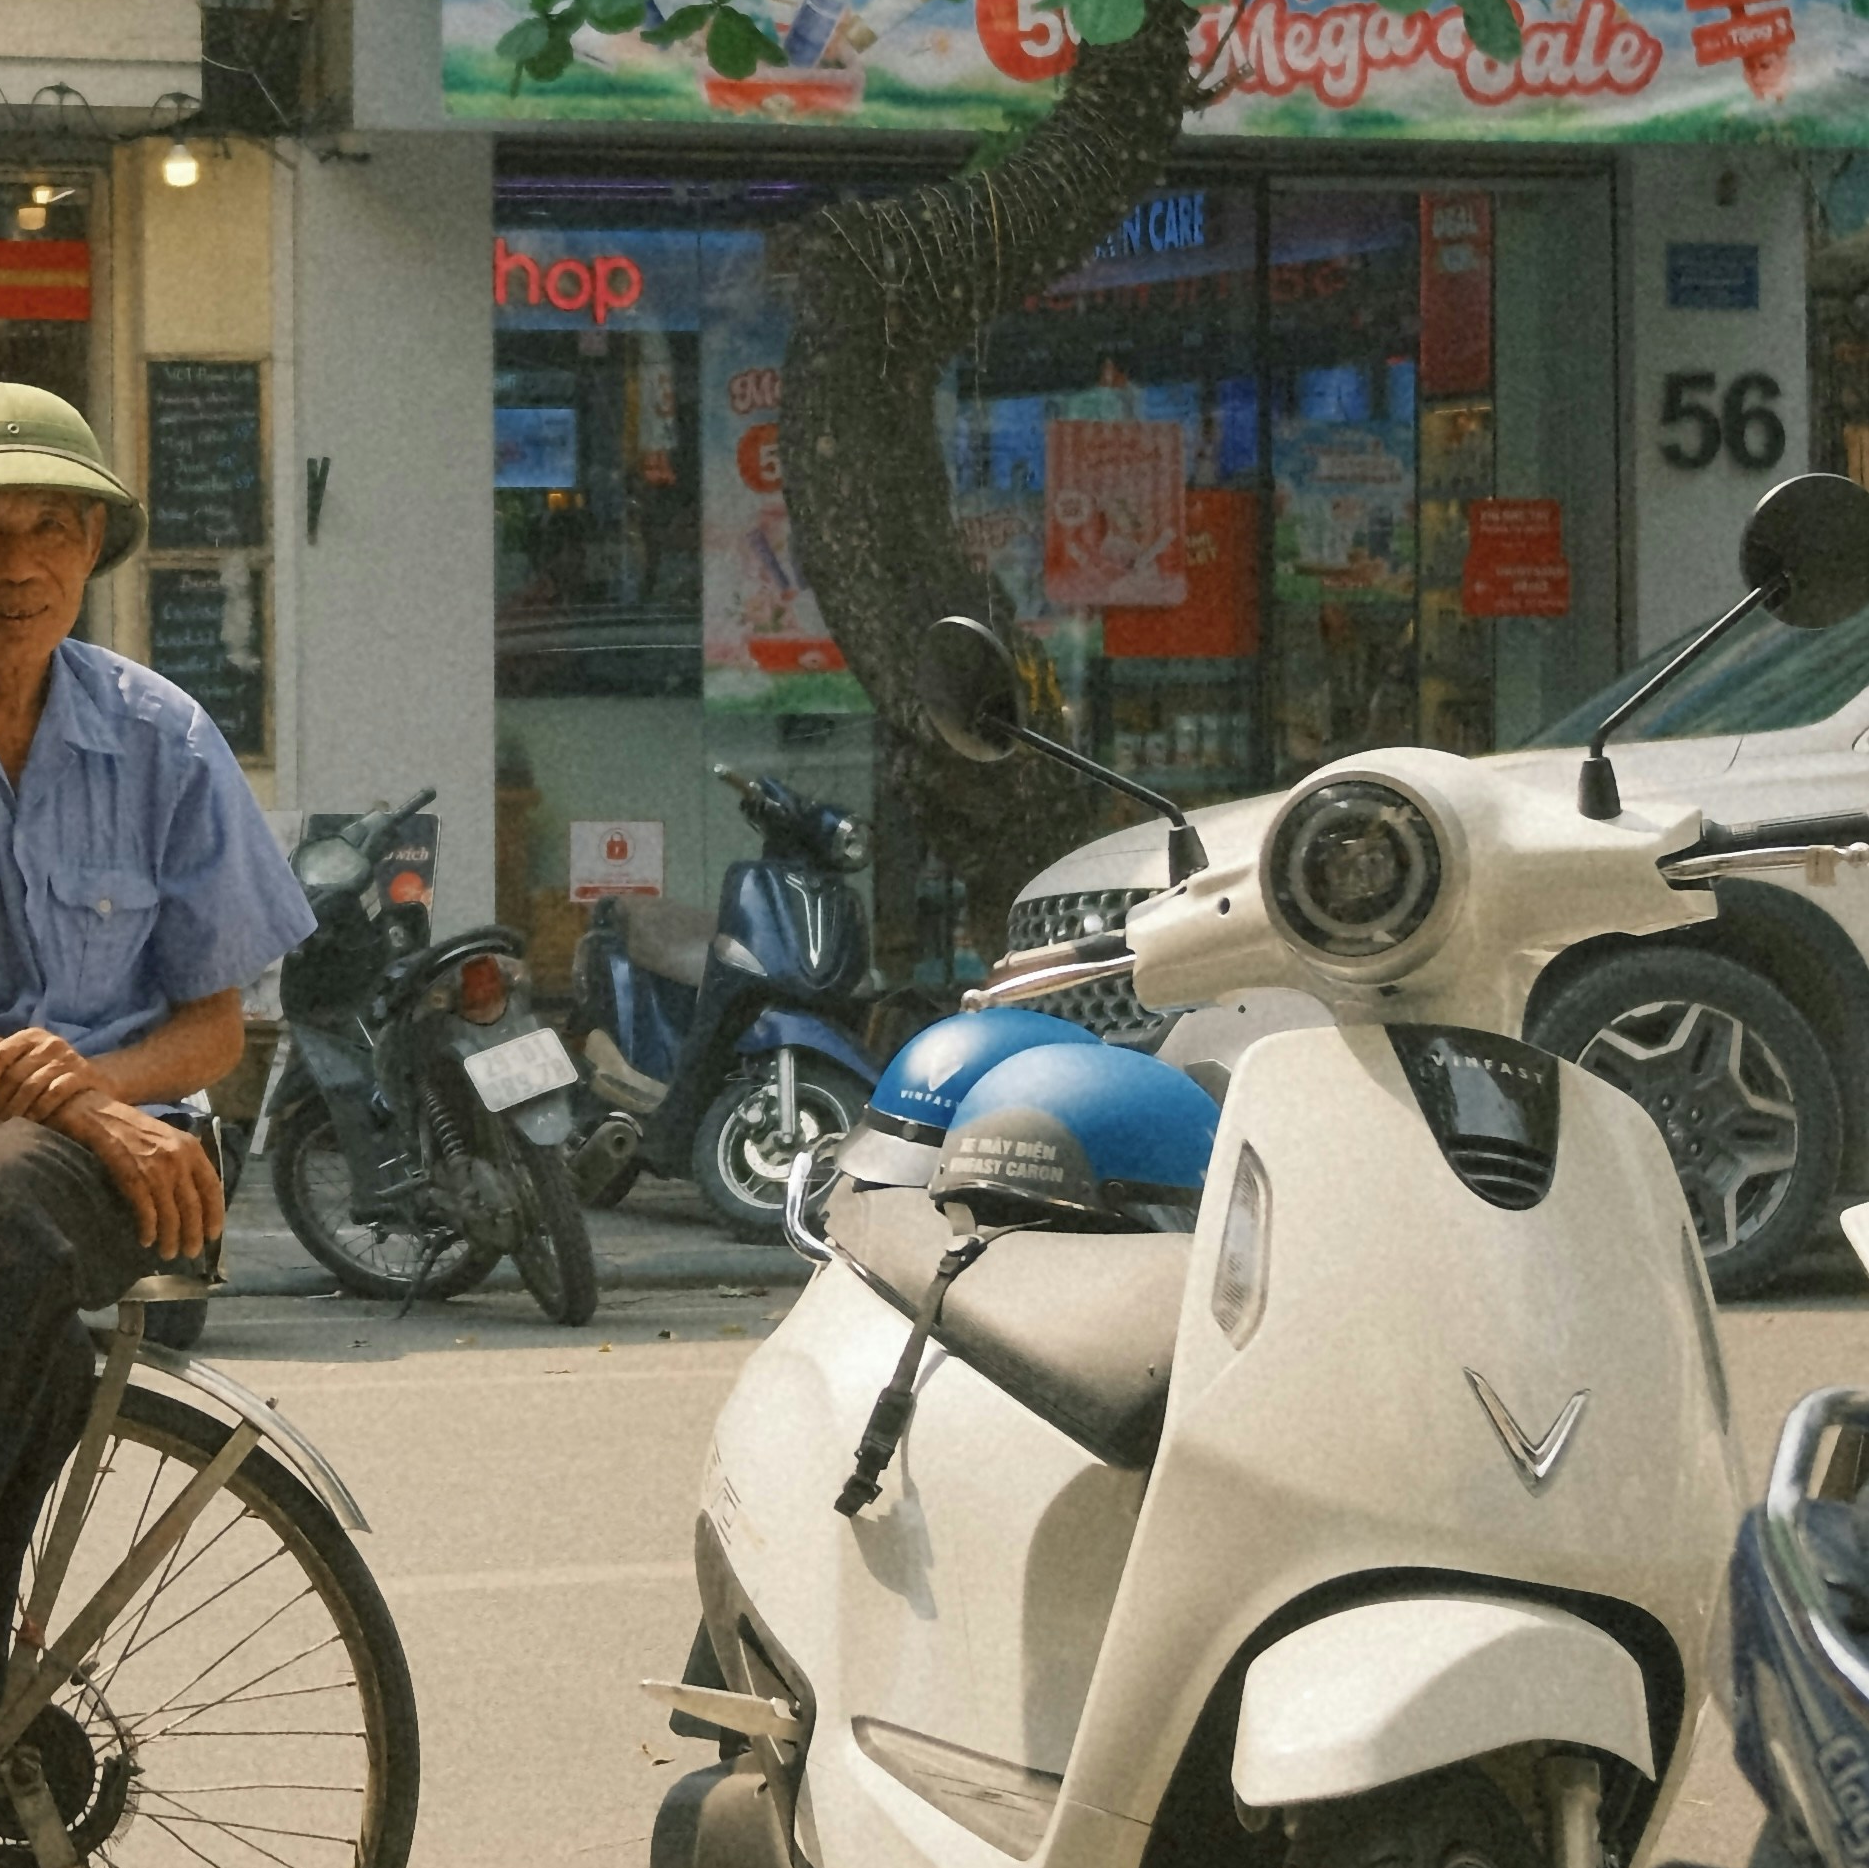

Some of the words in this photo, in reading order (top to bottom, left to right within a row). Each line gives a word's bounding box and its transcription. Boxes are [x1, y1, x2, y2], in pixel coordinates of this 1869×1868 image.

[1148, 194, 1206, 253] CARE
[1660, 372, 1786, 470] 56
[1430, 1053, 1544, 1085] VINFAST
